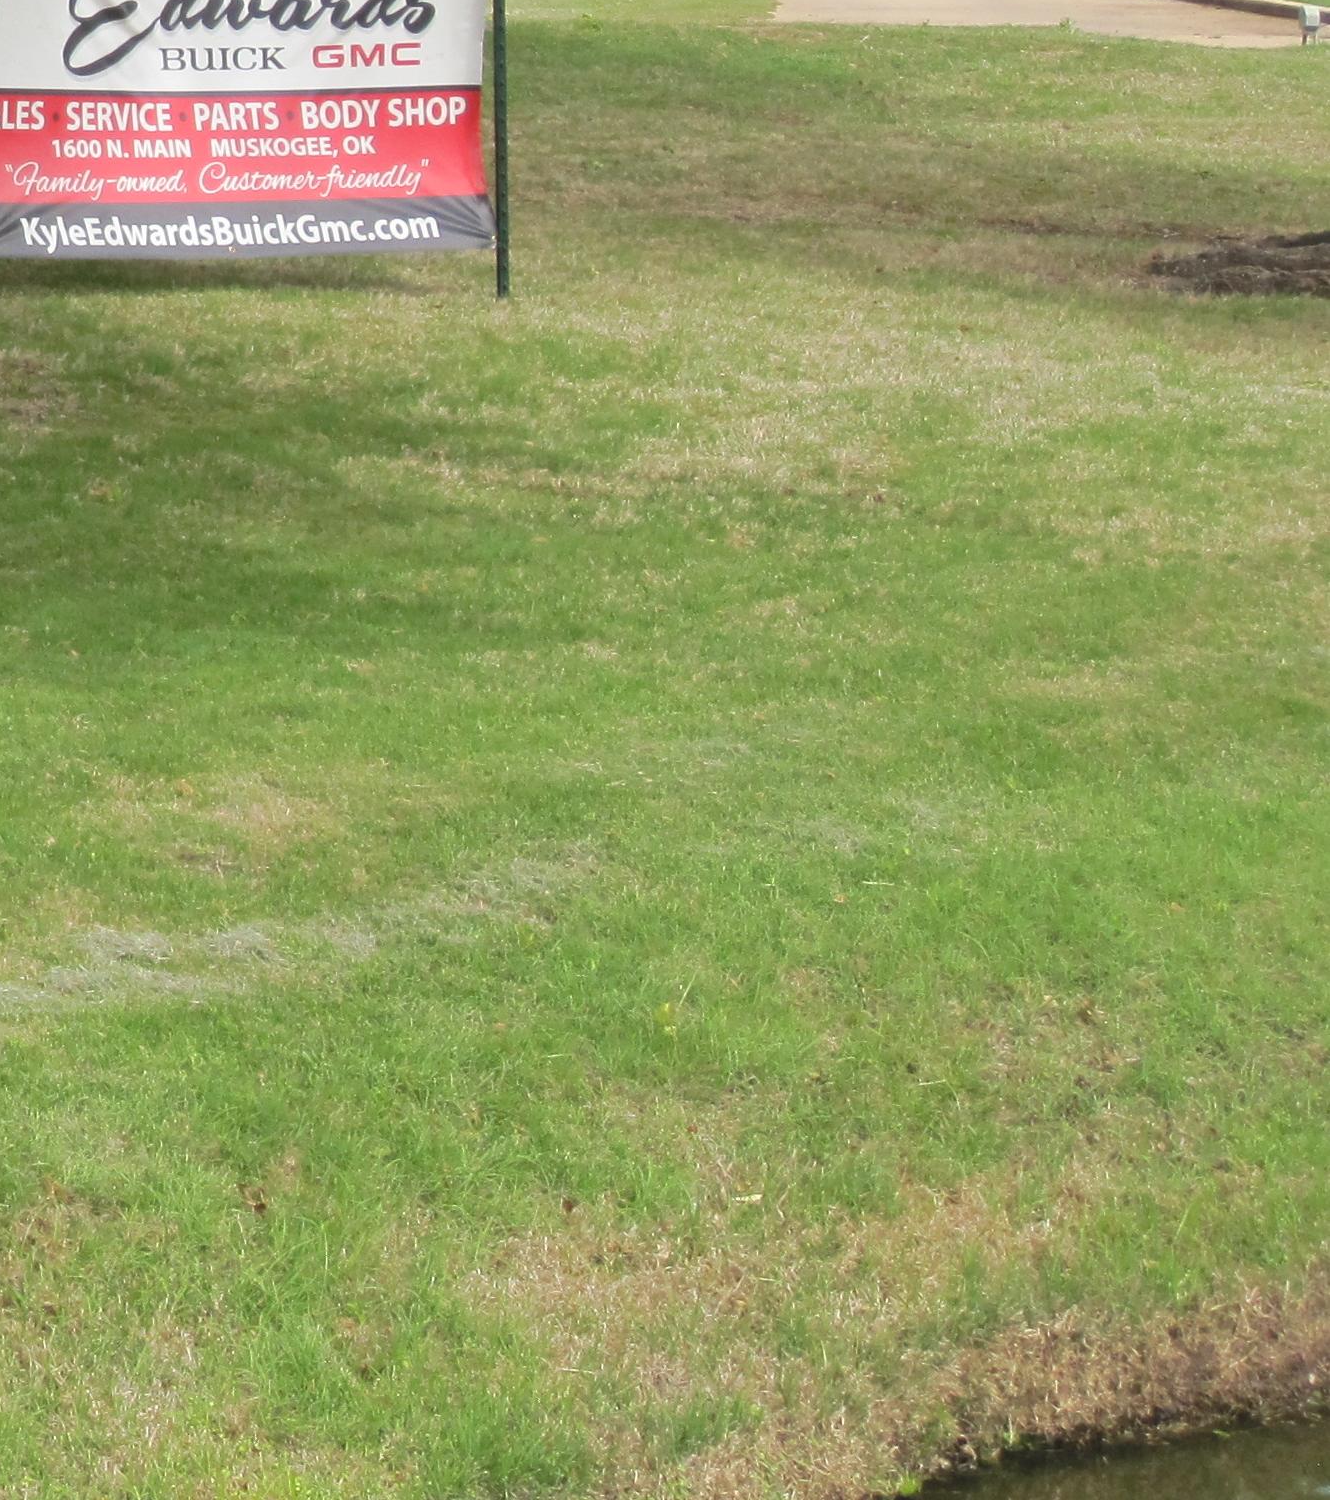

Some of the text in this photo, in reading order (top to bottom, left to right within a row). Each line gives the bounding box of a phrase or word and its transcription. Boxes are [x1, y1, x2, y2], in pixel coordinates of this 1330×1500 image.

[159, 42, 422, 72] BUICK GMC
[66, 102, 173, 132] SERVICE
[194, 101, 280, 132] PARTS
[300, 99, 380, 130] BODY
[388, 96, 467, 127] SHOP
[51, 135, 376, 159] 1600 N. MAIN MUSKOGEE, OK
[19, 213, 441, 254] KyleEdwardsBuickGmc.com
